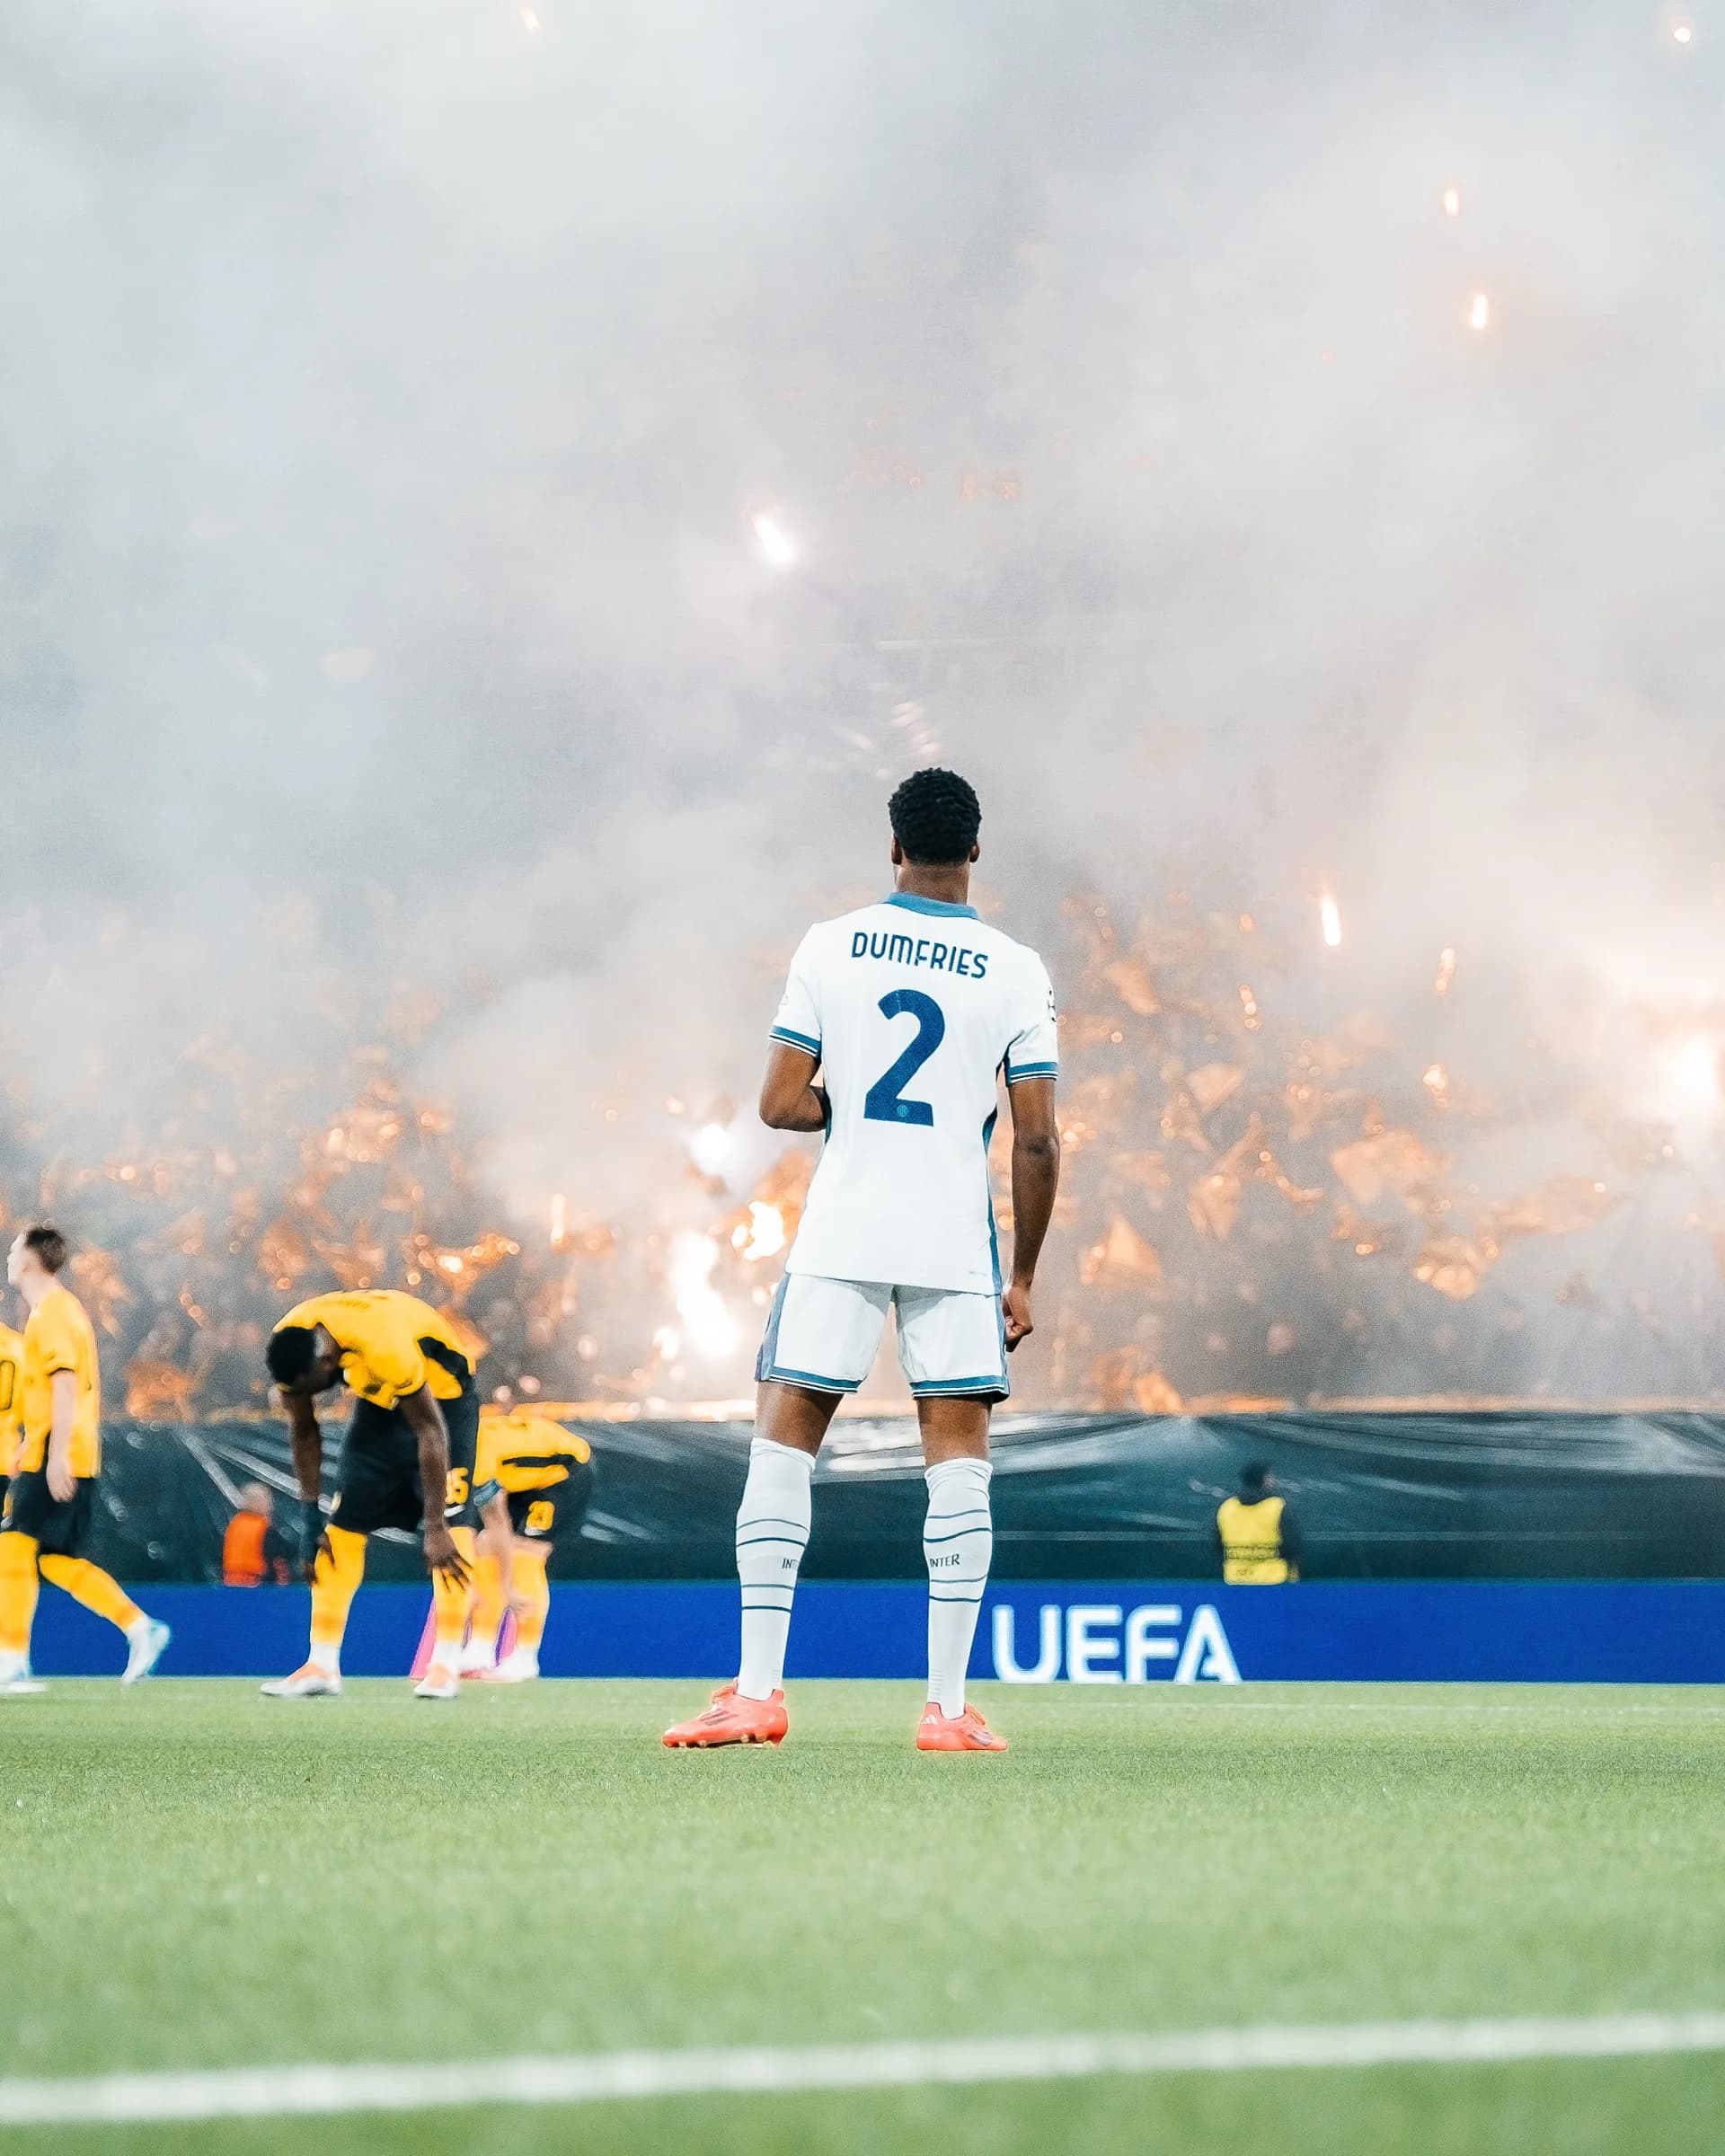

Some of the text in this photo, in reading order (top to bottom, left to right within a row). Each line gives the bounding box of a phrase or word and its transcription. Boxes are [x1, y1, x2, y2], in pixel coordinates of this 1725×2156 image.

[851, 932, 988, 979] DUMFRIES
[863, 988, 945, 1127] 2
[991, 1604, 1243, 1685] UEFA
